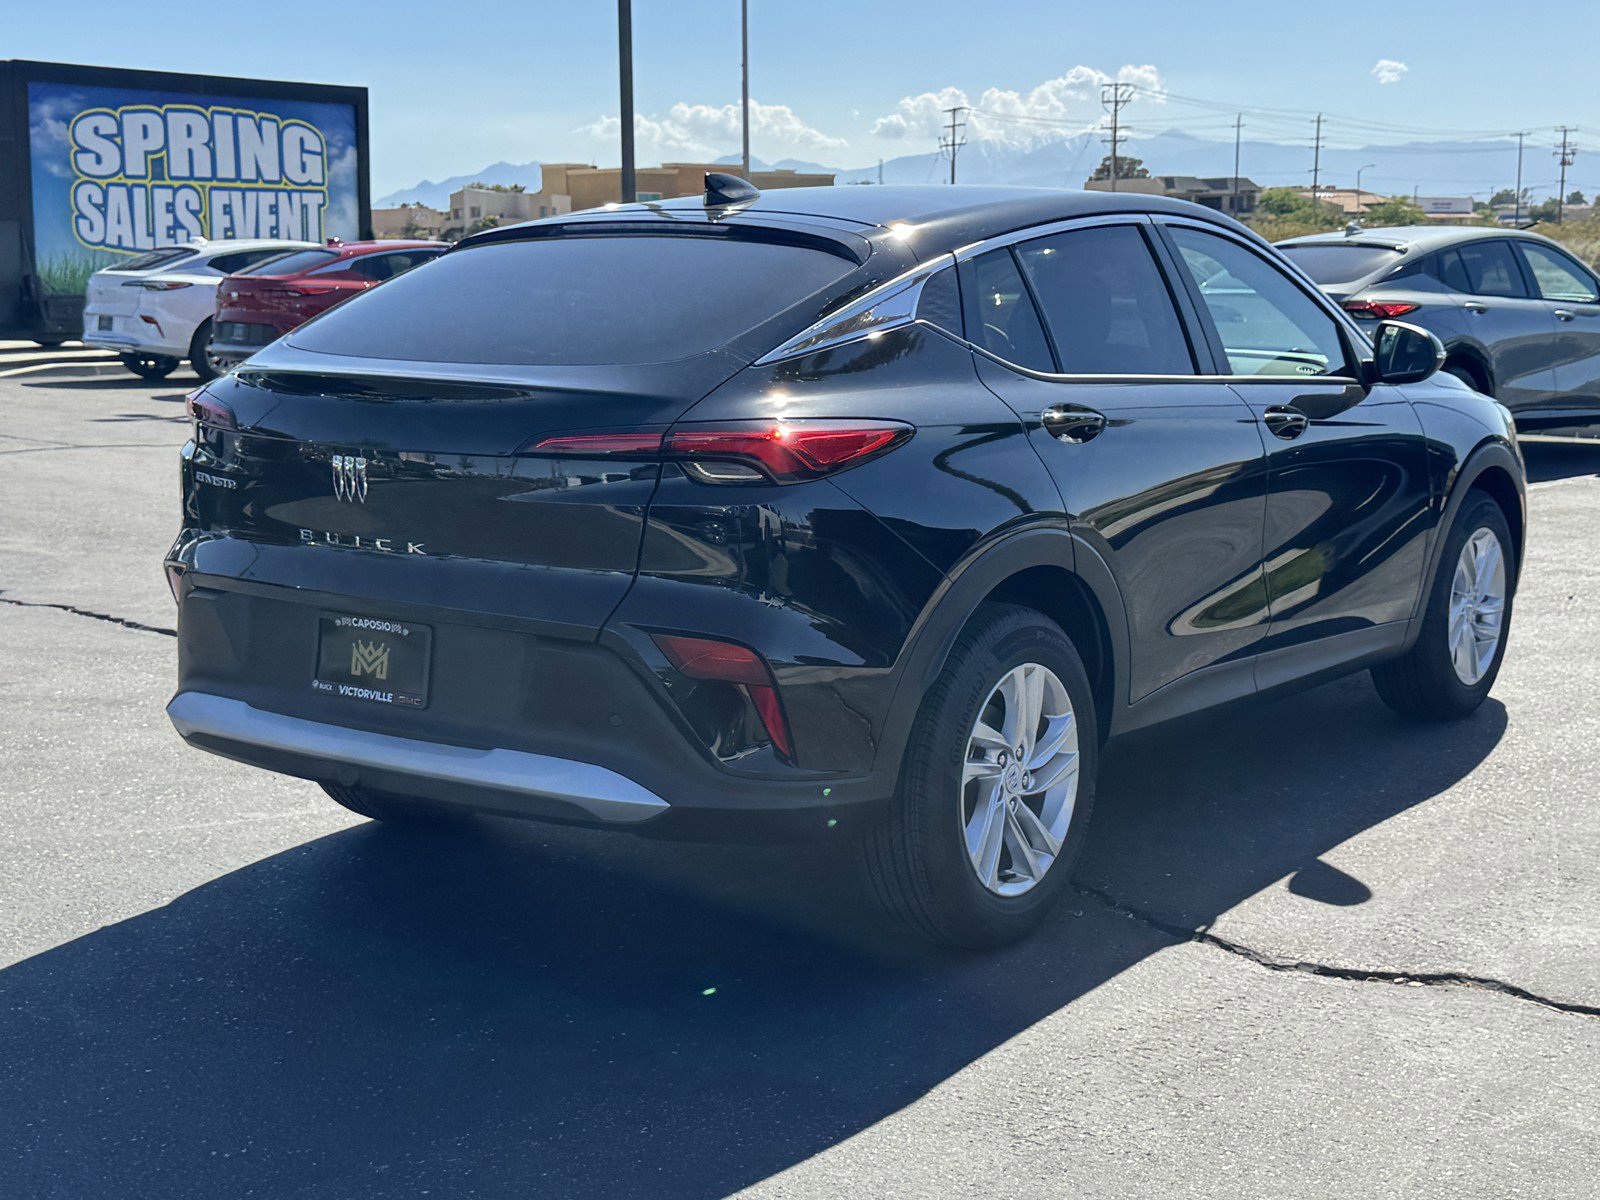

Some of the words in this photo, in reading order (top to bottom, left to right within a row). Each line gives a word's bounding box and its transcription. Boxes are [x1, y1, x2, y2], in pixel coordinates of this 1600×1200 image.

[73, 109, 325, 187] SPRING
[75, 182, 201, 249] SALES
[210, 188, 324, 242] EVENT
[299, 528, 427, 555] BUICK
[351, 617, 391, 632] CAPOSIO
[338, 684, 394, 703] VICTORVILLE
